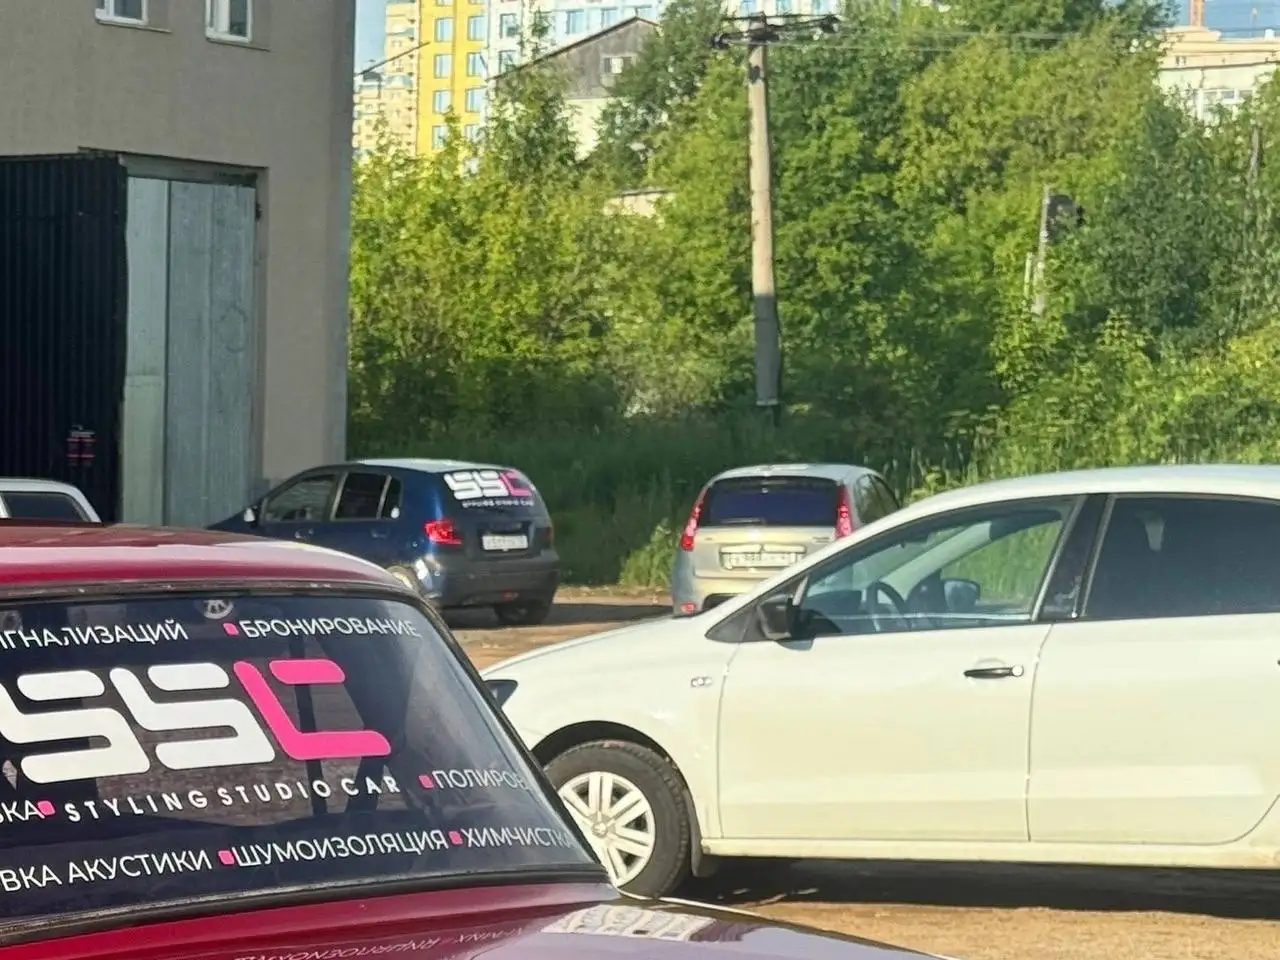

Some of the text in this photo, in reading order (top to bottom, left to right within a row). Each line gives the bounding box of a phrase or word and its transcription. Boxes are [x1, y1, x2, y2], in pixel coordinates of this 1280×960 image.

[443, 468, 532, 500] SSC
[238, 616, 422, 639] БРОНИРОВАНИЕ
[63, 775, 401, 823] STYLING STUDIO CAR
[231, 829, 449, 867] ШУМОИЗОЛЯЦИЯ
[67, 850, 213, 884] АКУСТИКИ
